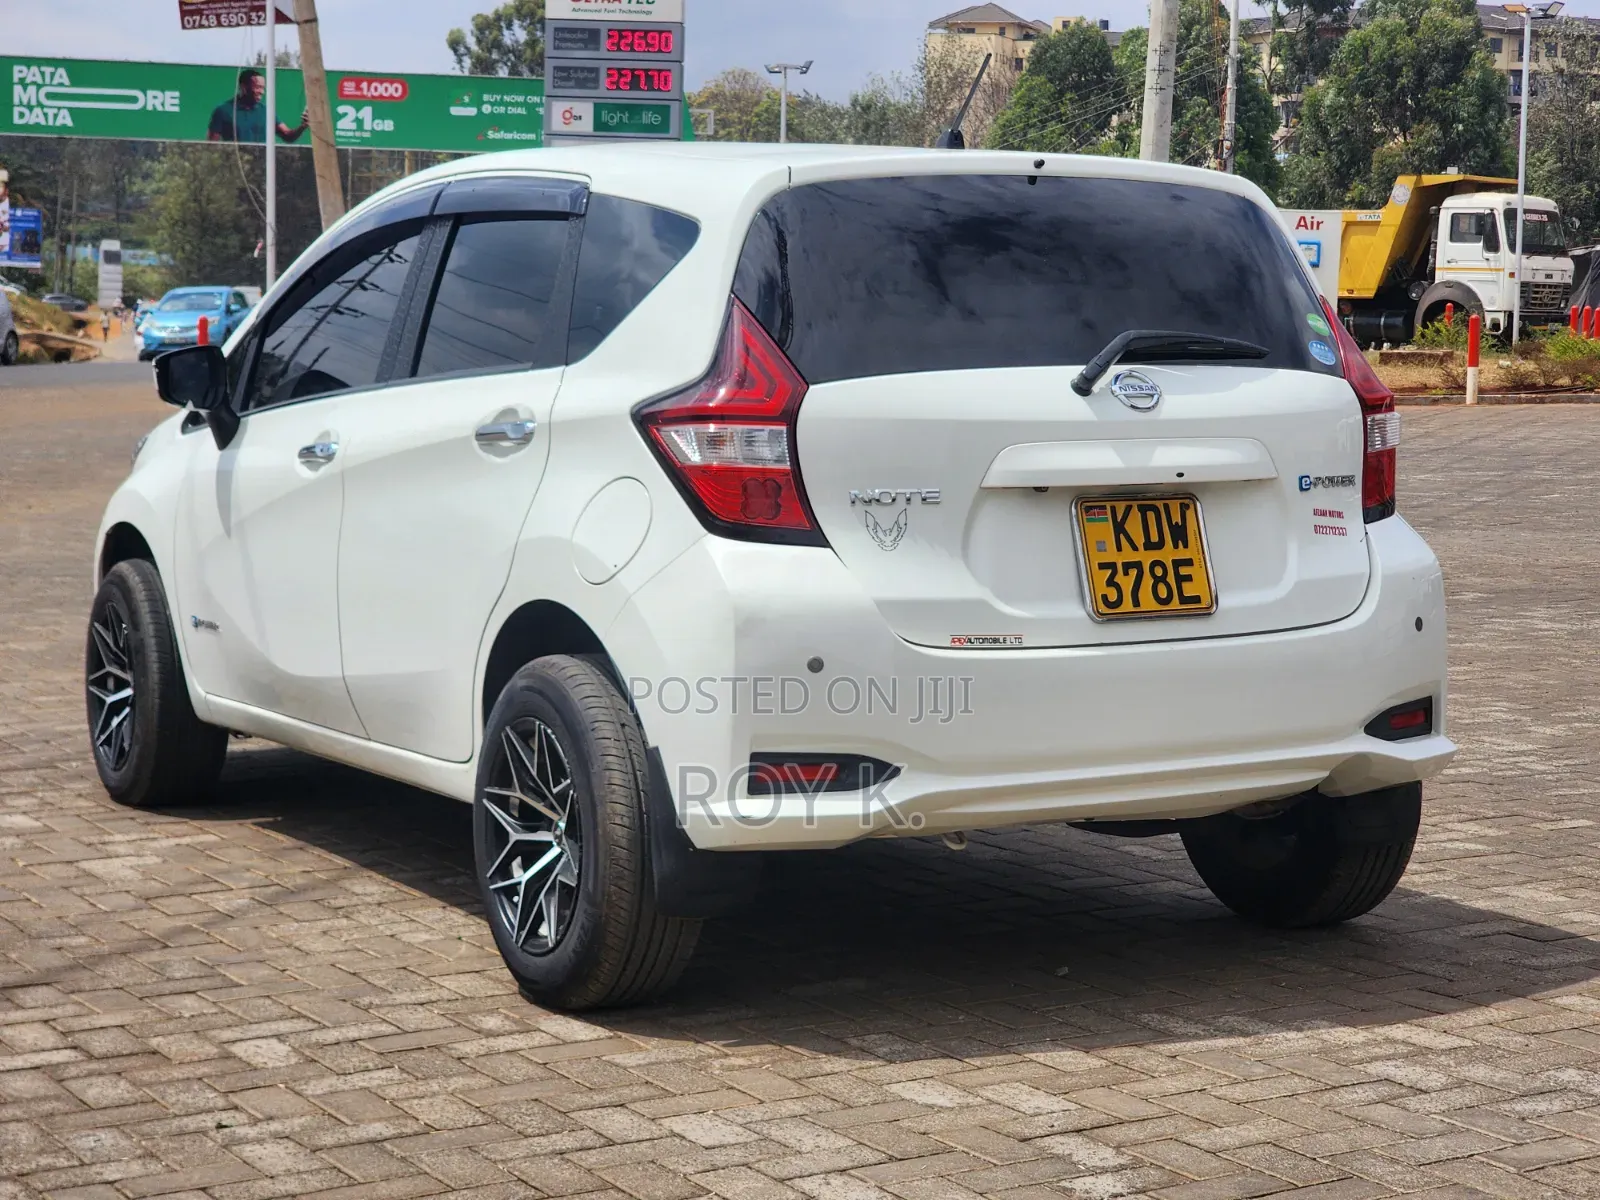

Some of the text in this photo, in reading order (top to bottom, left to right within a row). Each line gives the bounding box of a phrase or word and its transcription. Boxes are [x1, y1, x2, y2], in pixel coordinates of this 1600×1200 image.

[184, 16, 217, 28] 0748
[220, 13, 247, 26] 690
[249, 11, 266, 25] 32
[619, 8, 653, 16] Technology
[606, 30, 673, 53] 226.90
[12, 65, 71, 86] PATA
[360, 81, 403, 98] 1,000
[482, 94, 502, 102] BUY
[503, 95, 526, 103] NOW
[13, 106, 74, 127] DATA
[492, 106, 527, 115] OR DIAL
[601, 110, 630, 126] light
[642, 111, 662, 125] life
[486, 130, 537, 141] Safaricom
[1295, 215, 1325, 231] Air
[1118, 384, 1158, 392] NISSAN
[849, 488, 942, 506] NOTE
[1110, 503, 1190, 552] KDW
[1098, 558, 1202, 610] 378E
